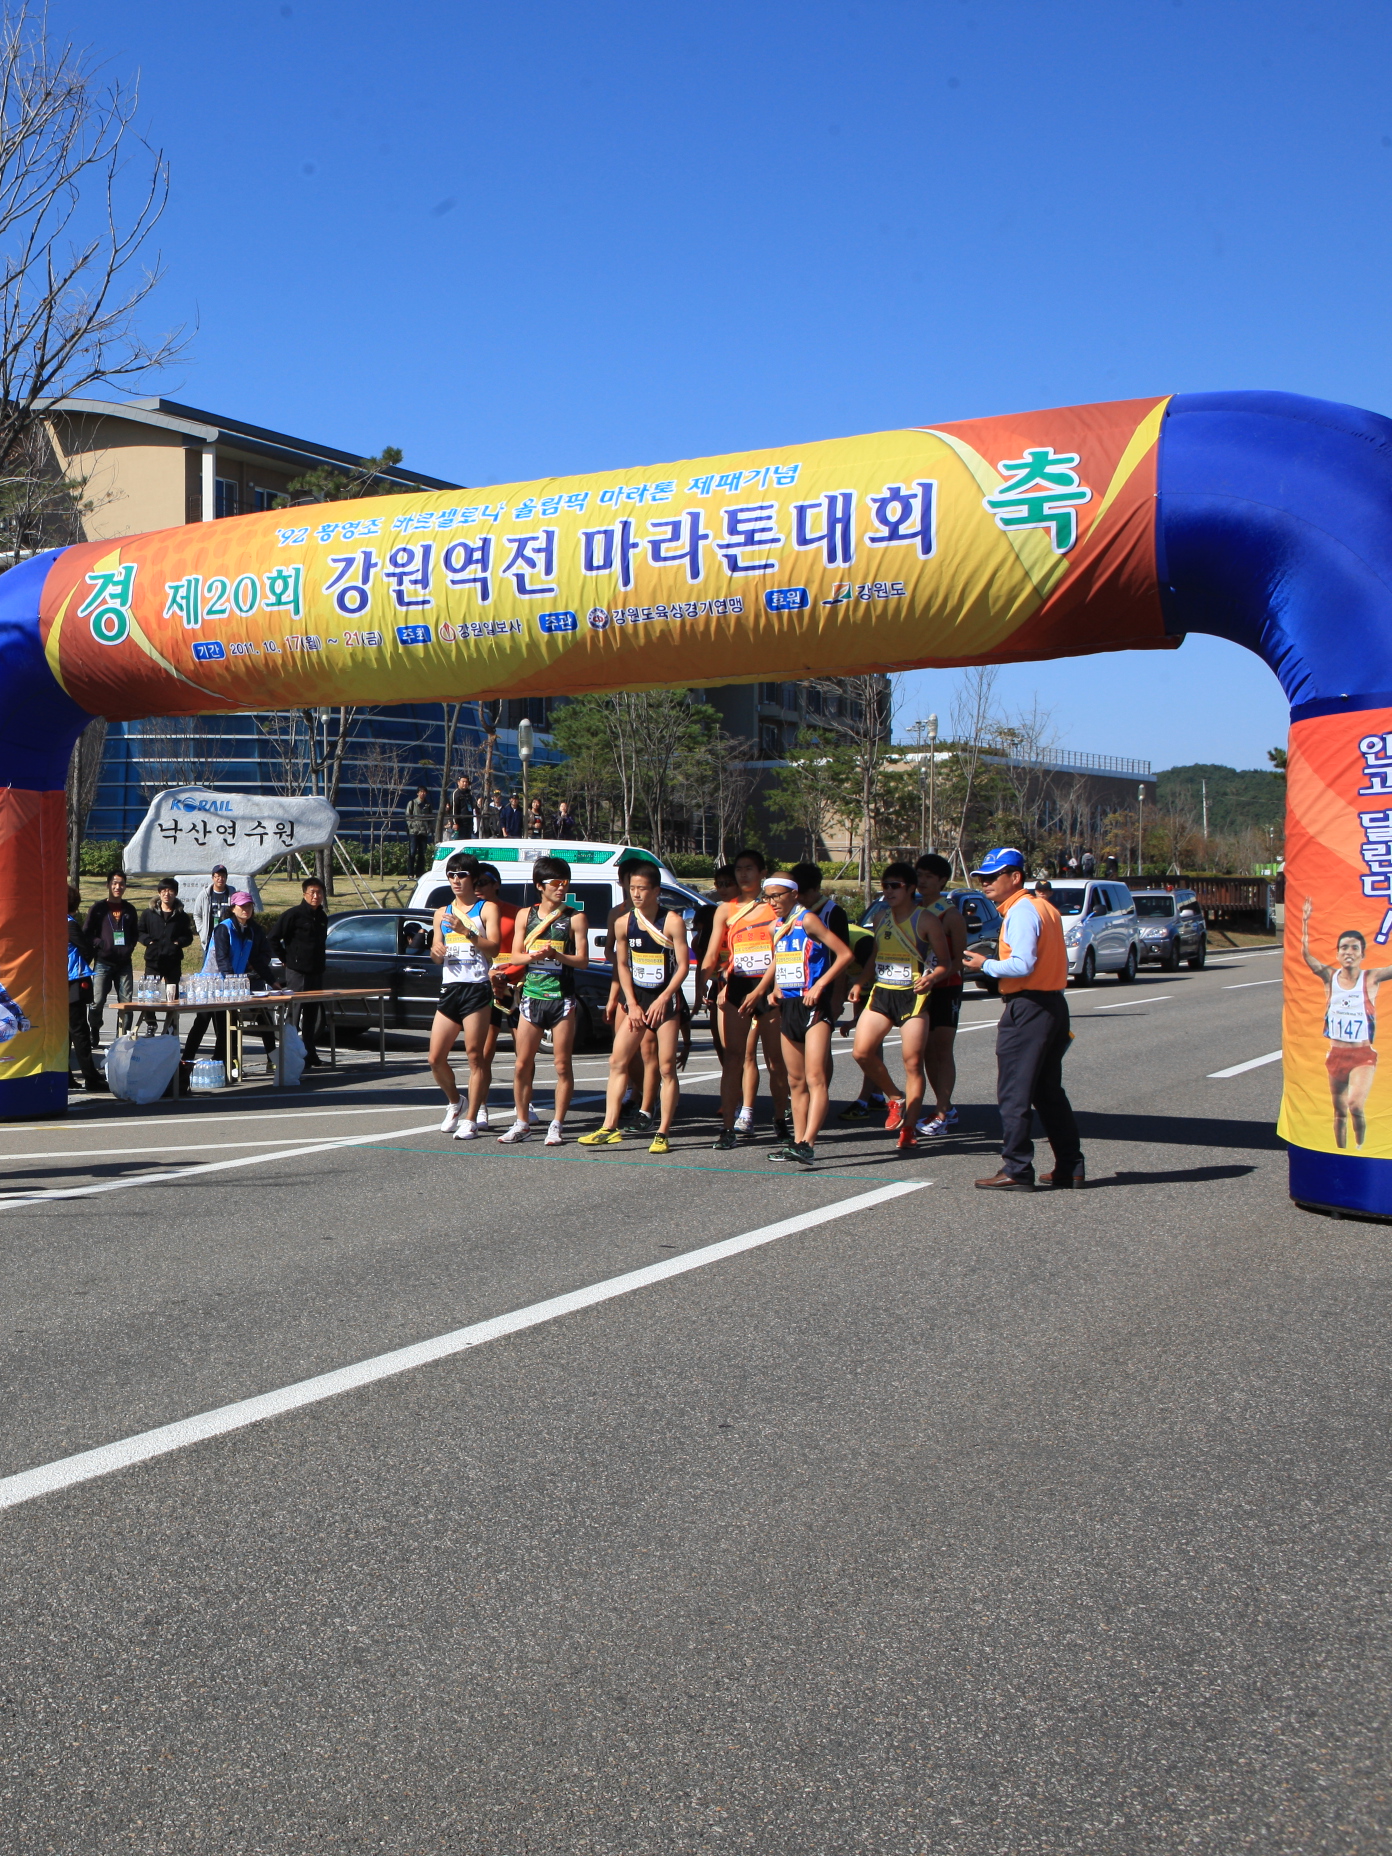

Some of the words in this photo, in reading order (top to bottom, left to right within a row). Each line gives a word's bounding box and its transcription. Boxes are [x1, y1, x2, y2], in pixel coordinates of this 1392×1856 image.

[275, 526, 310, 546] '92
[315, 517, 384, 544] 황영조
[391, 501, 506, 534] 바르셀로나
[512, 491, 589, 521] 올림픽
[598, 480, 675, 510] 마라톤
[685, 463, 801, 497] 제패기념
[982, 447, 1092, 554] 축
[163, 564, 304, 628] 제20회
[322, 527, 559, 618] 강원역전
[579, 478, 937, 592] 마라톤대회
[78, 563, 137, 645] 경
[770, 589, 803, 610] 후원
[856, 581, 906, 600] 강원도
[543, 613, 574, 631] 주관
[612, 596, 744, 626] 강원도육상경기연맹
[197, 645, 221, 659] 기간
[285, 635, 322, 651] 17(월)
[343, 631, 383, 648] 21(금)
[401, 627, 428, 644] 주최
[457, 618, 522, 638] 강원일보사
[170, 796, 234, 813] KORAIL
[158, 818, 295, 847] 낙산연수원
[1330, 1017, 1363, 1040] 1147
